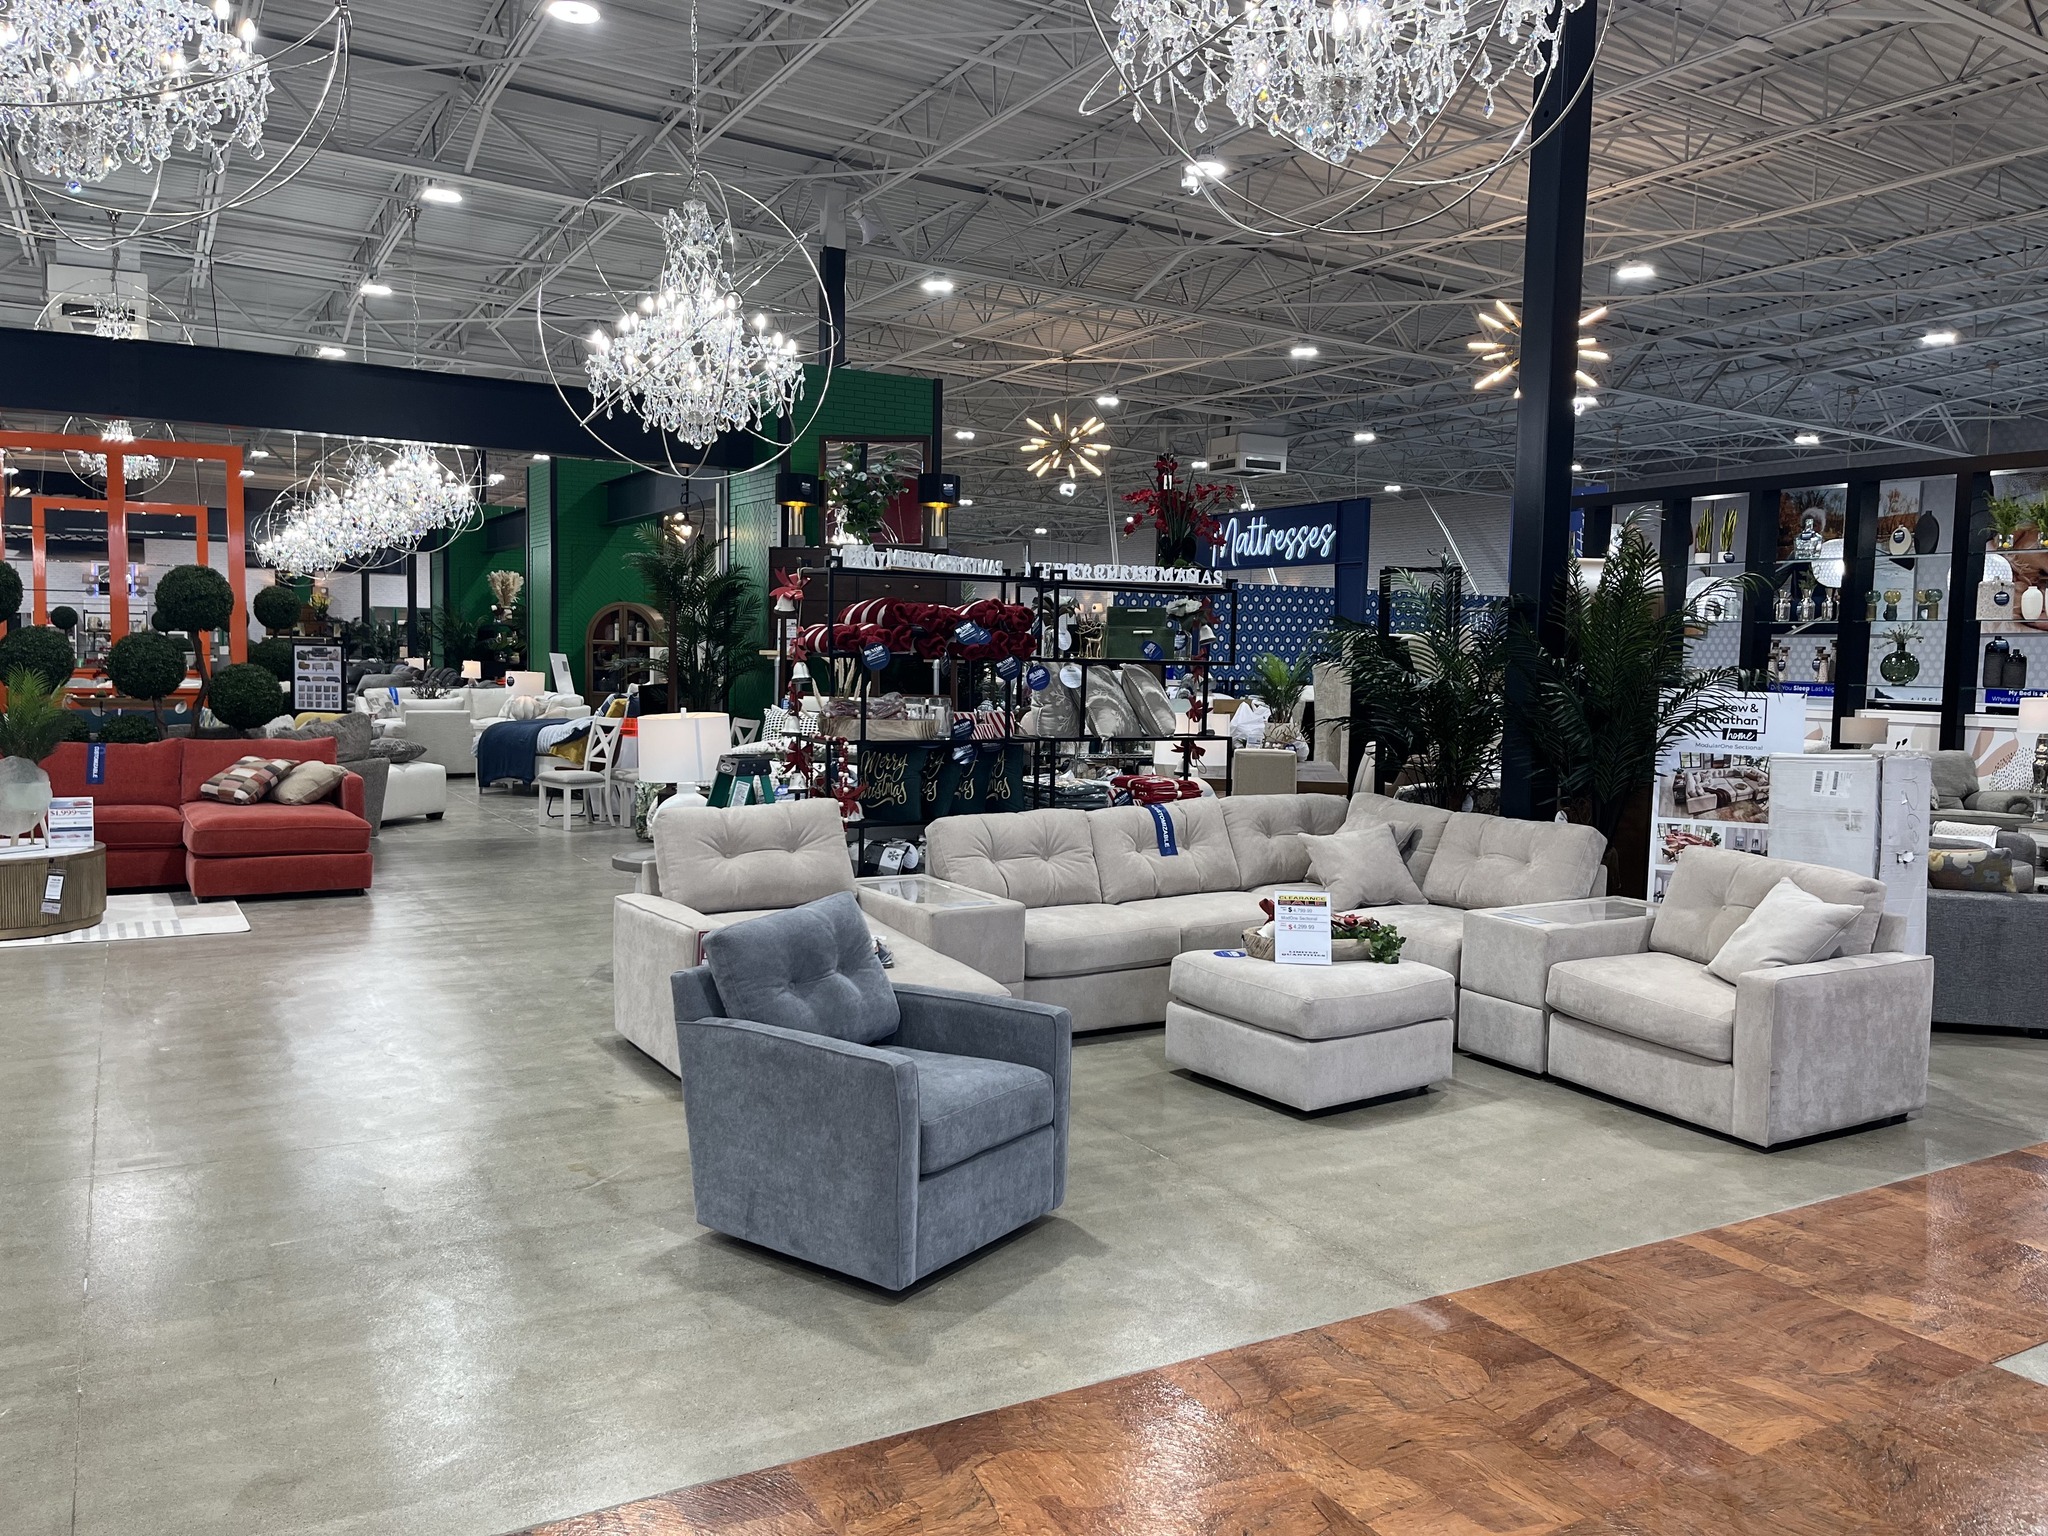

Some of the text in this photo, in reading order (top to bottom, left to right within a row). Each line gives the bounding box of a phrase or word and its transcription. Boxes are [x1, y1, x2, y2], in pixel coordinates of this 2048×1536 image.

[1211, 515, 1337, 568] Mattresses
[1793, 684, 1810, 693] Sleep
[1750, 703, 1759, 713] &
[1725, 728, 1756, 740] home
[1695, 742, 1734, 750] ModularOne
[92, 745, 100, 779] CUSTOMIZABLE
[860, 750, 908, 782] Merry
